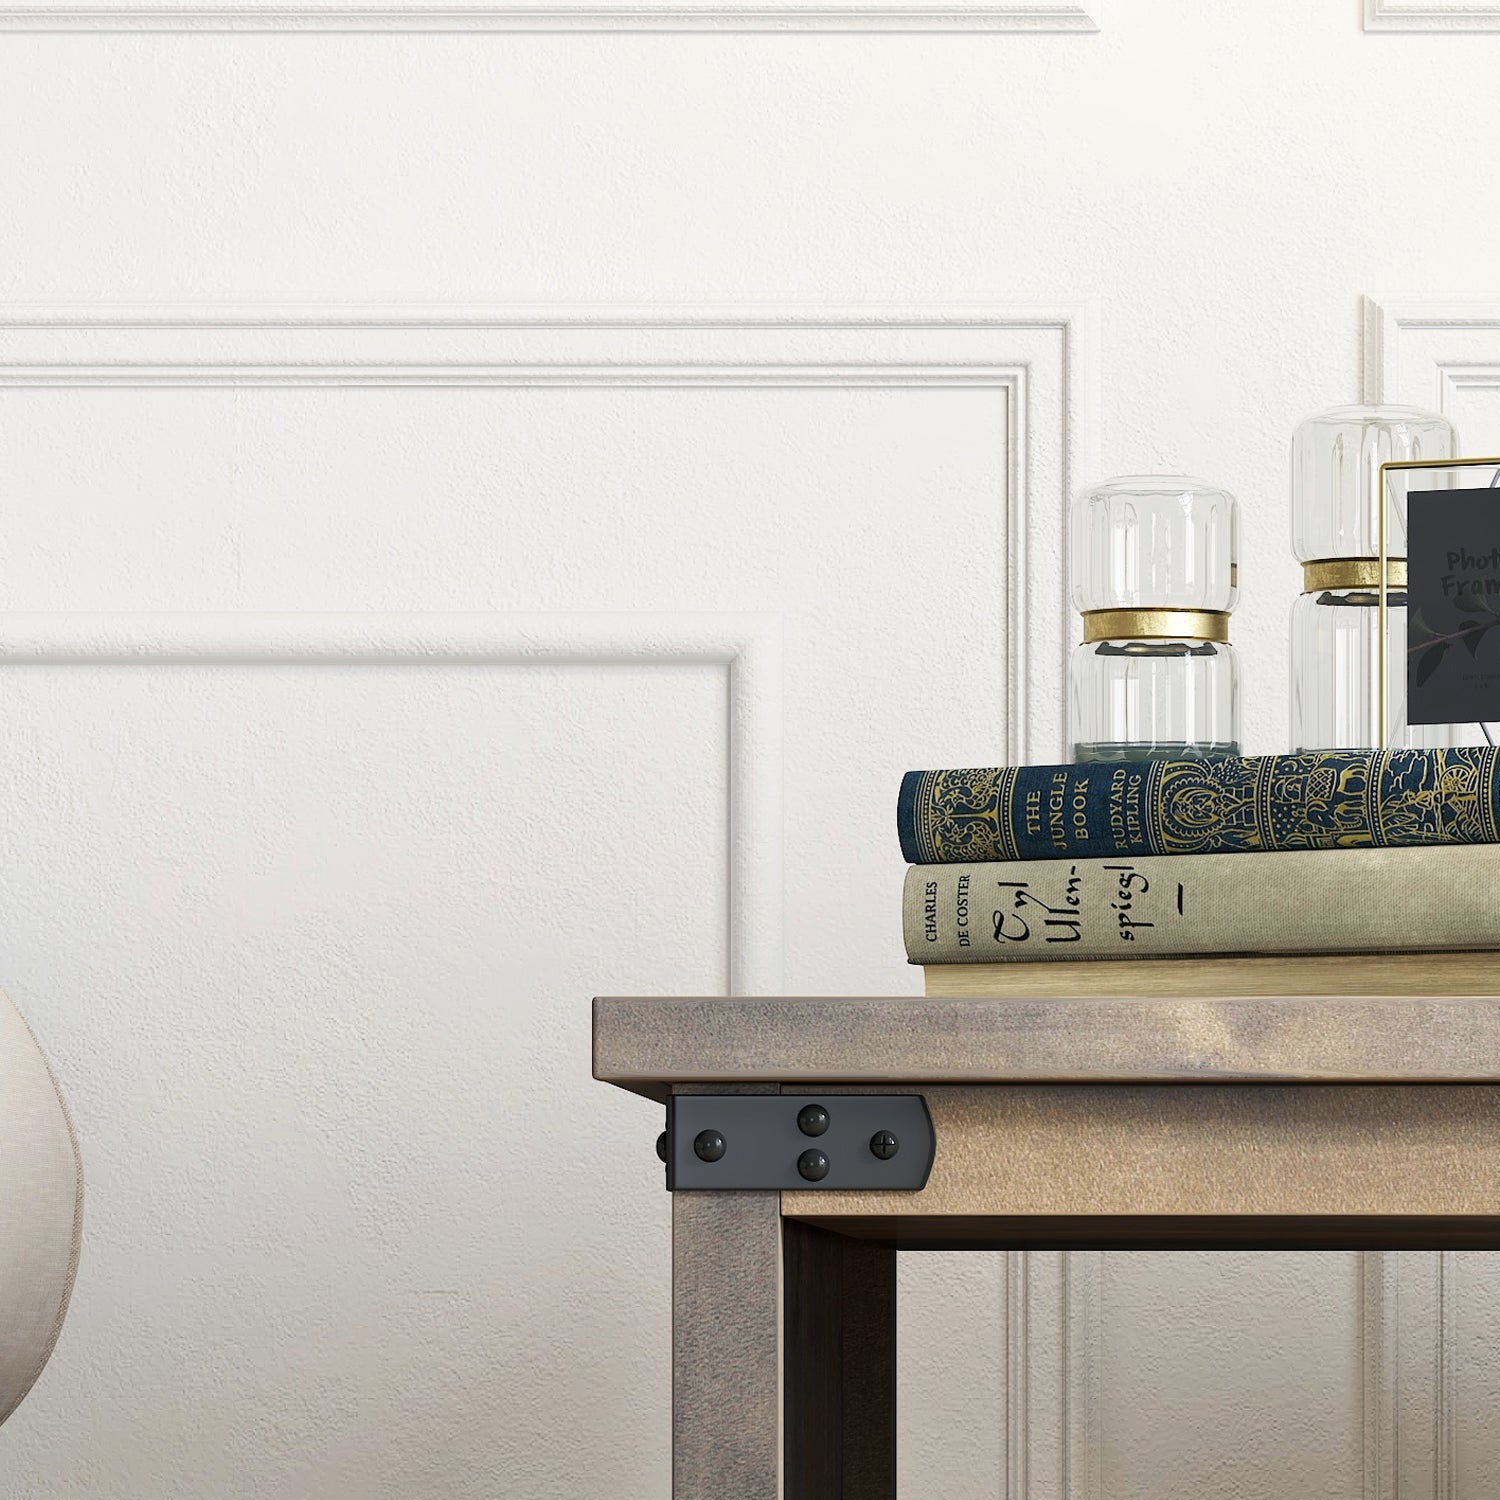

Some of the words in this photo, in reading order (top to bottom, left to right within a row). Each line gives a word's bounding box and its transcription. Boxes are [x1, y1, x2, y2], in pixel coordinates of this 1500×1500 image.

[1025, 789, 1042, 837] THE
[1048, 771, 1069, 850] JUNGLE
[1073, 777, 1090, 841] BOOK
[1110, 768, 1128, 850] RUDYARD
[1127, 774, 1143, 845] KIPLING
[924, 880, 938, 943] CHARLES
[958, 874, 971, 926] COSTER
[959, 927, 971, 947] DE
